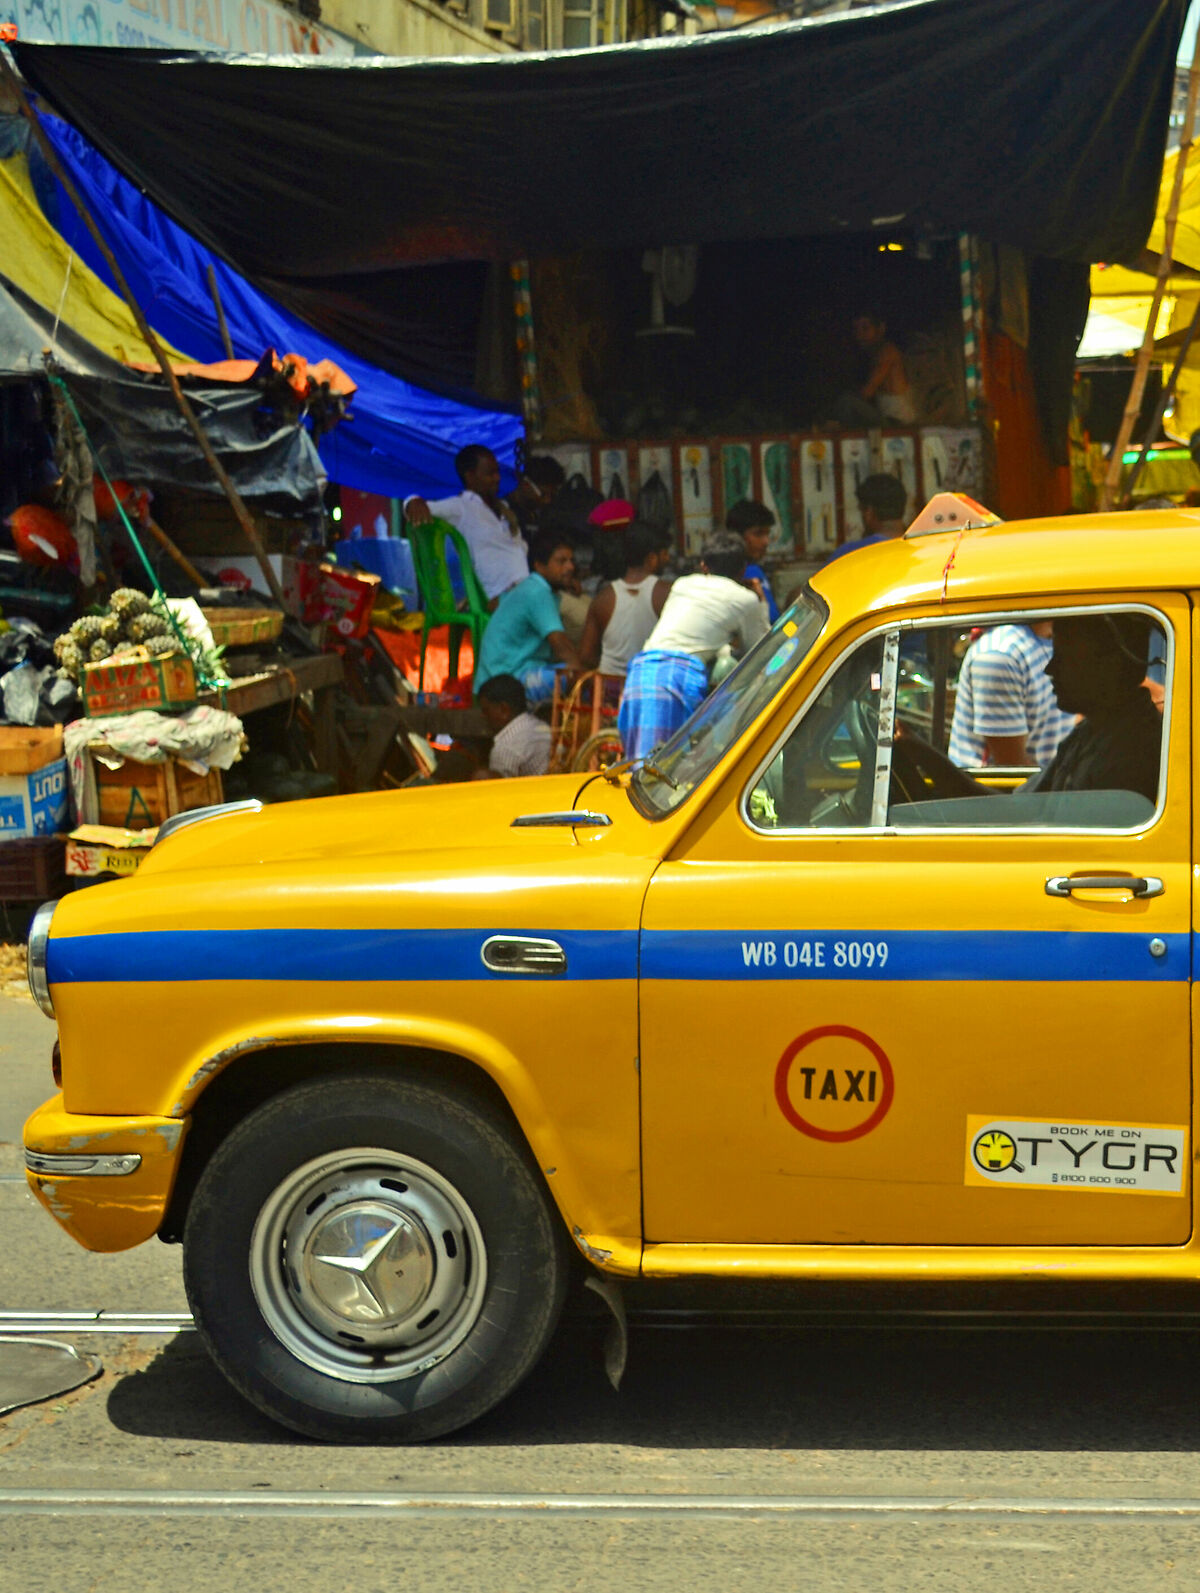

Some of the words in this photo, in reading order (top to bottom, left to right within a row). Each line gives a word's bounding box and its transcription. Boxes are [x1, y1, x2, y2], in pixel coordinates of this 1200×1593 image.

[741, 941, 777, 967] WB
[784, 941, 826, 968] 04E
[833, 941, 889, 968] 8099
[800, 1067, 877, 1102] TAXI
[1050, 1126, 1089, 1137] BOOK
[1094, 1127, 1115, 1137] ME
[1121, 1128, 1142, 1138] ON
[1061, 1174, 1086, 1183] 8100
[1089, 1175, 1111, 1184] 600
[1114, 1176, 1137, 1185] 900
